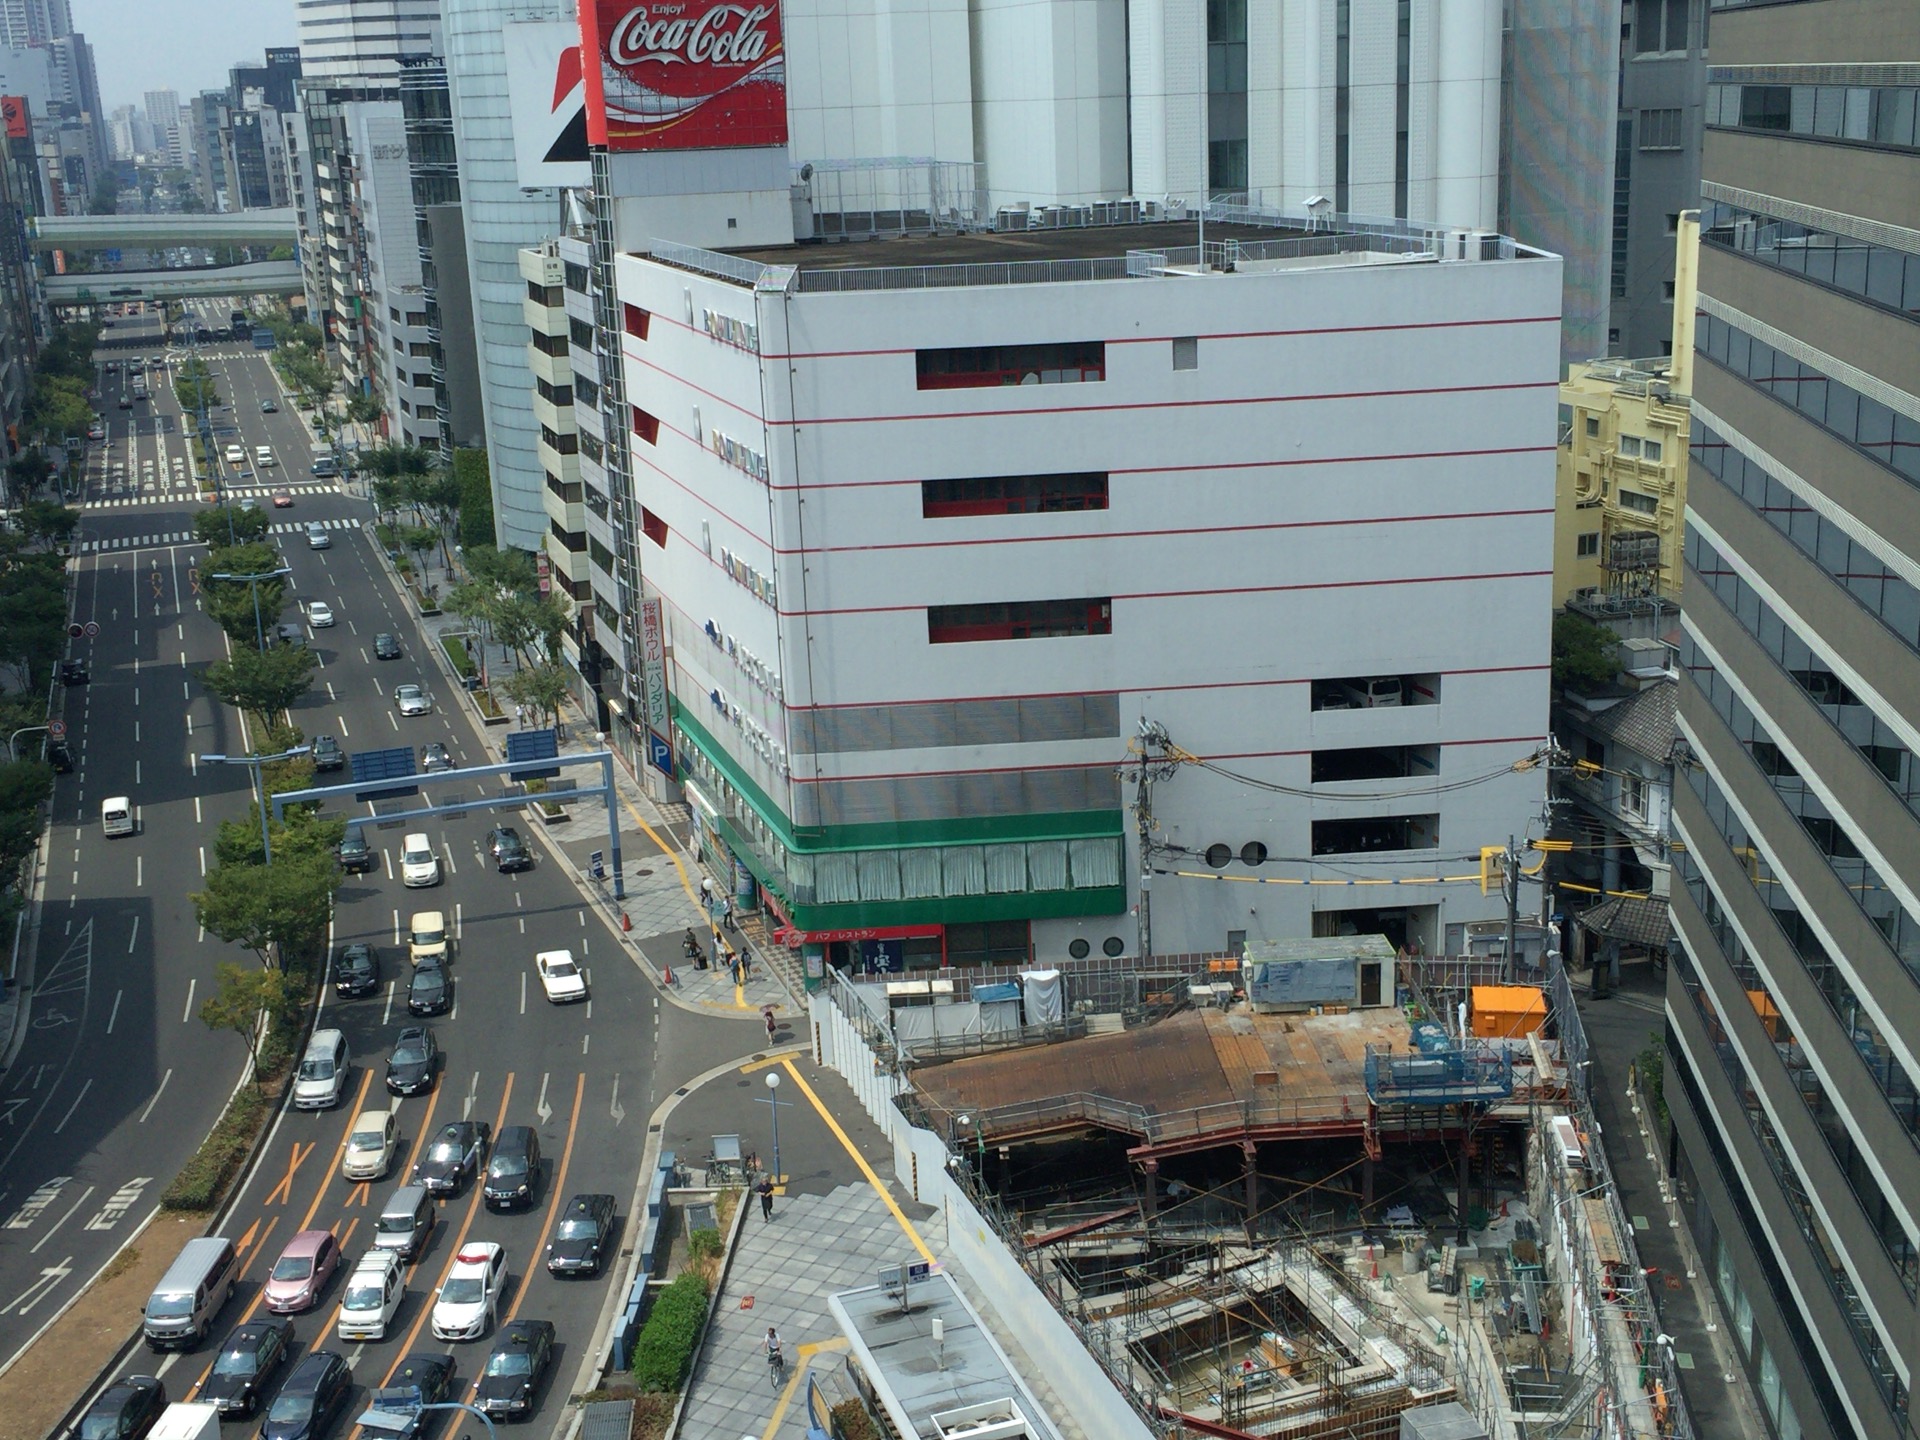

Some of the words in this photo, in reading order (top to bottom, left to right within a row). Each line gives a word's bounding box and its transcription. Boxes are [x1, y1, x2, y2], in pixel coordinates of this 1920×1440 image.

[652, 3, 686, 16] Enjoy!
[608, 3, 777, 66] Coca-Cola
[648, 673, 665, 725] バンダリア
[655, 745, 669, 764] P
